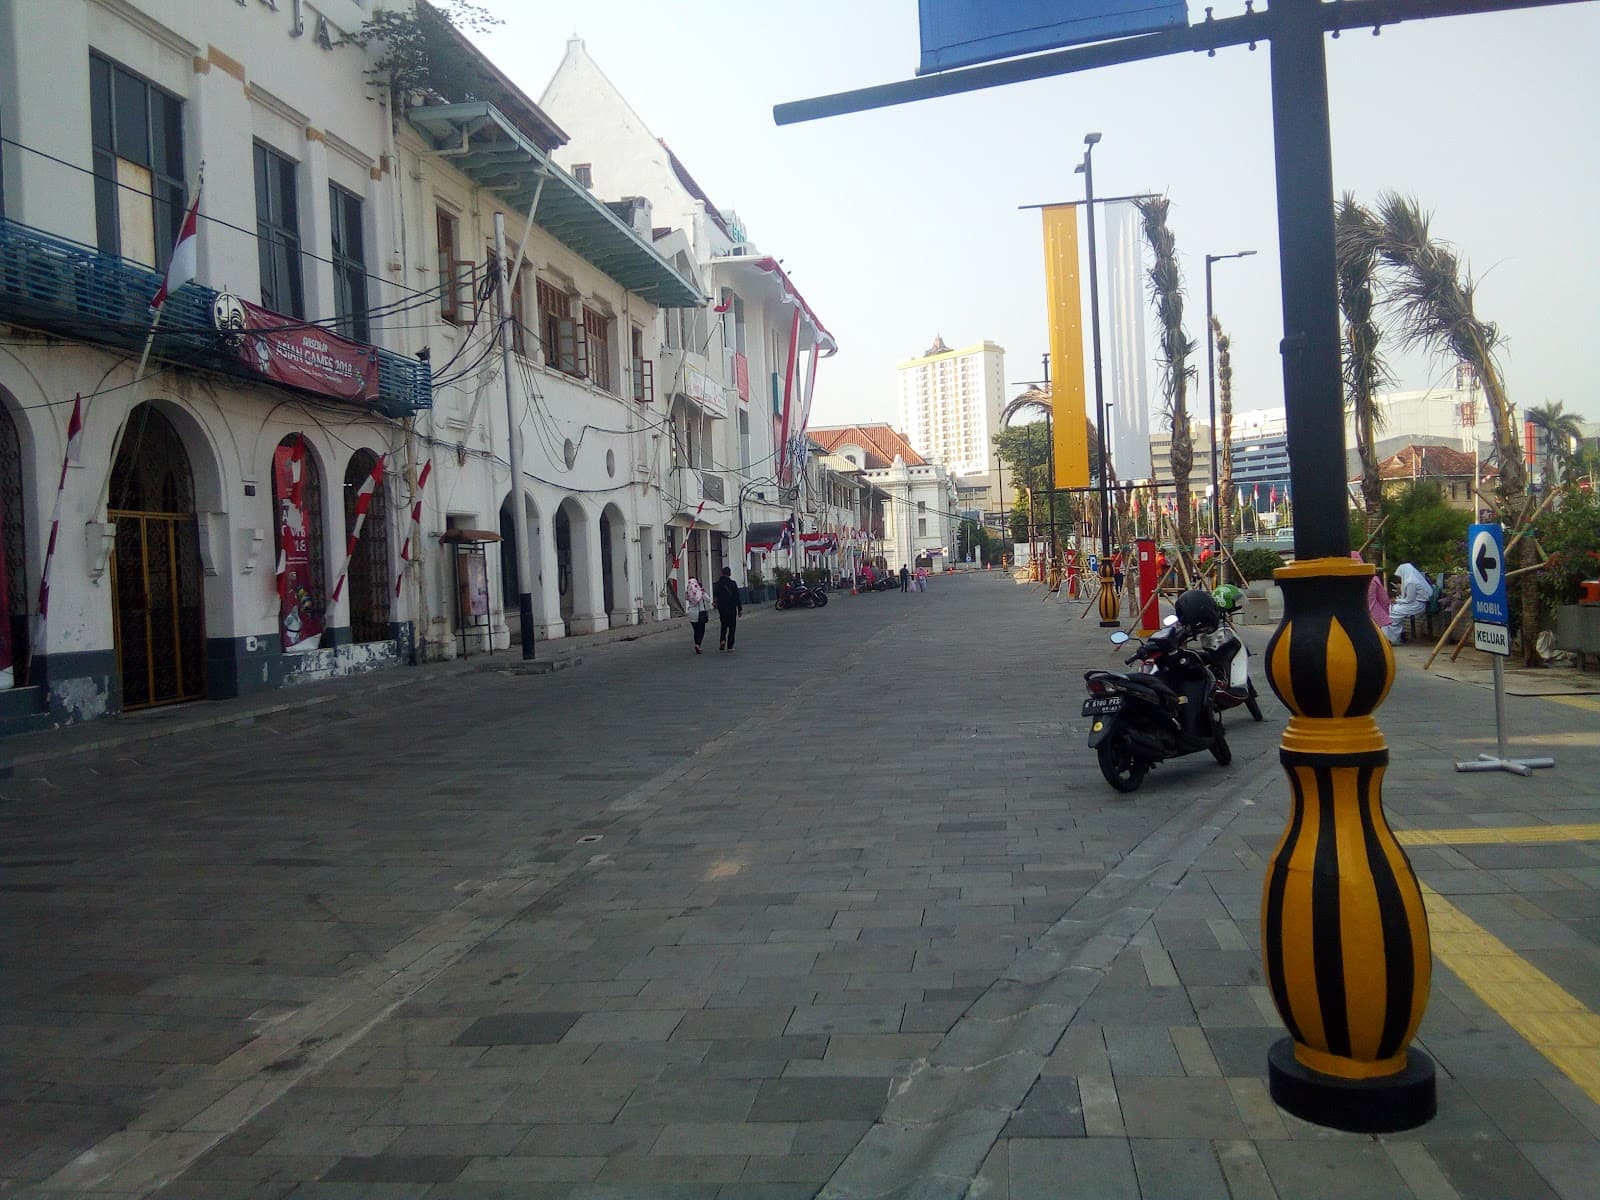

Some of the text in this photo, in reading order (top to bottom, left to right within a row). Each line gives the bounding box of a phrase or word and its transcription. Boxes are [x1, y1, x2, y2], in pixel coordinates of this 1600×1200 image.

[276, 340, 304, 363] ASIAN
[304, 350, 333, 371] GAMES
[334, 359, 353, 377] 2018
[1476, 601, 1503, 616] MOBIL
[1476, 630, 1506, 646] KELUAR
